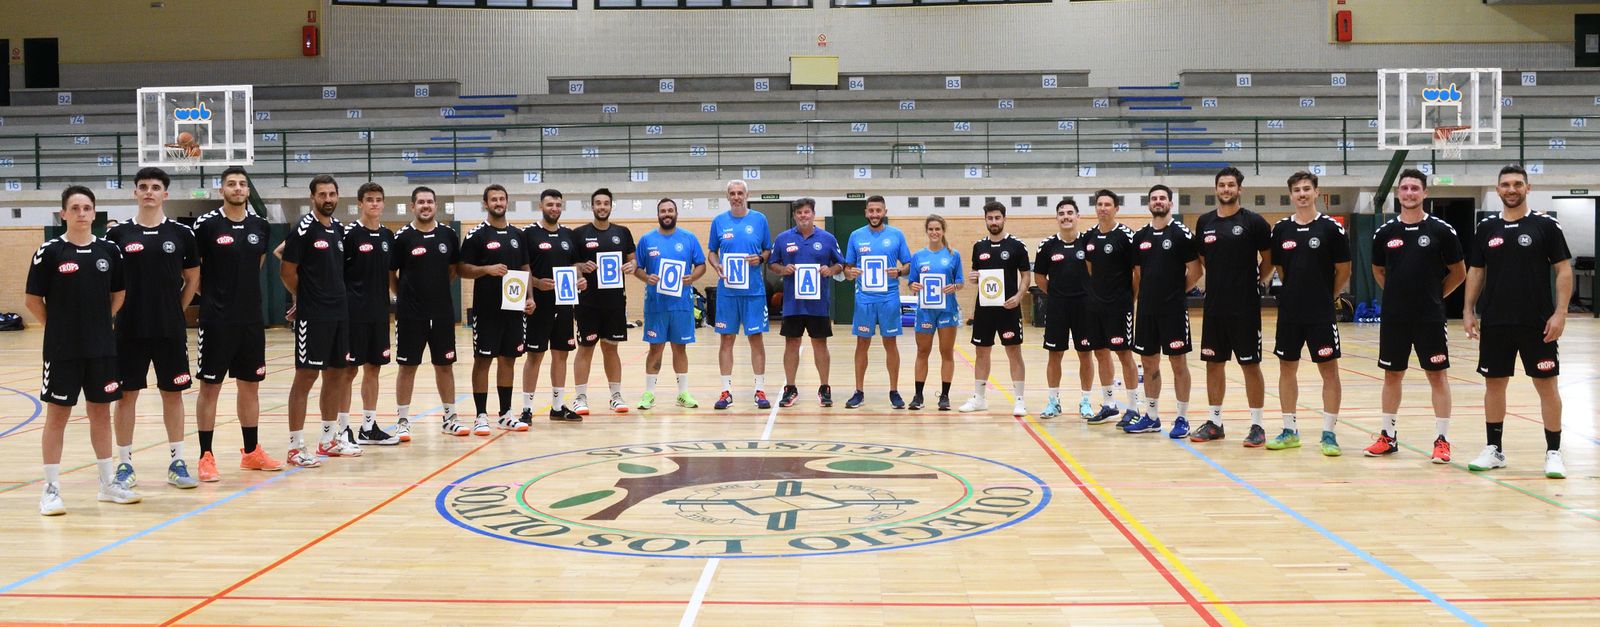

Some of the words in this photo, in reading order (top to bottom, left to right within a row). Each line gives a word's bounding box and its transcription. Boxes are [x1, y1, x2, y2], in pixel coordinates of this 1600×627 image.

[850, 80, 863, 88] 84
[947, 80, 960, 88] 83
[1043, 78, 1056, 86] 82
[1239, 77, 1249, 86] 81
[1332, 77, 1345, 85] 80
[1523, 76, 1536, 84] 78
[570, 84, 582, 92] 87
[660, 82, 673, 90] 86
[756, 82, 768, 90] 85
[324, 89, 336, 98] 89
[416, 88, 428, 96] 88
[59, 95, 71, 104] 92
[746, 169, 758, 178] 10
[858, 168, 866, 177] 9
[969, 168, 977, 176] 8
[1084, 166, 1092, 176] 7
[1314, 164, 1320, 174] 6
[1422, 164, 1428, 174] 5
[1530, 164, 1538, 174] 4
[528, 172, 538, 182] 12
[634, 172, 644, 181] 11
[9, 180, 19, 190] 16
[603, 258, 616, 281] B
[730, 260, 743, 282] N
[868, 262, 882, 284] T
[664, 265, 678, 288] O
[801, 270, 815, 293] A
[560, 274, 573, 297] A
[986, 284, 997, 292] M
[509, 286, 519, 296] M
[926, 280, 940, 302] E
[586, 442, 938, 458] AGUSTINOS
[451, 485, 571, 538] OLIVOS
[788, 486, 1033, 551] COLEGIO
[574, 534, 757, 555] LOS
